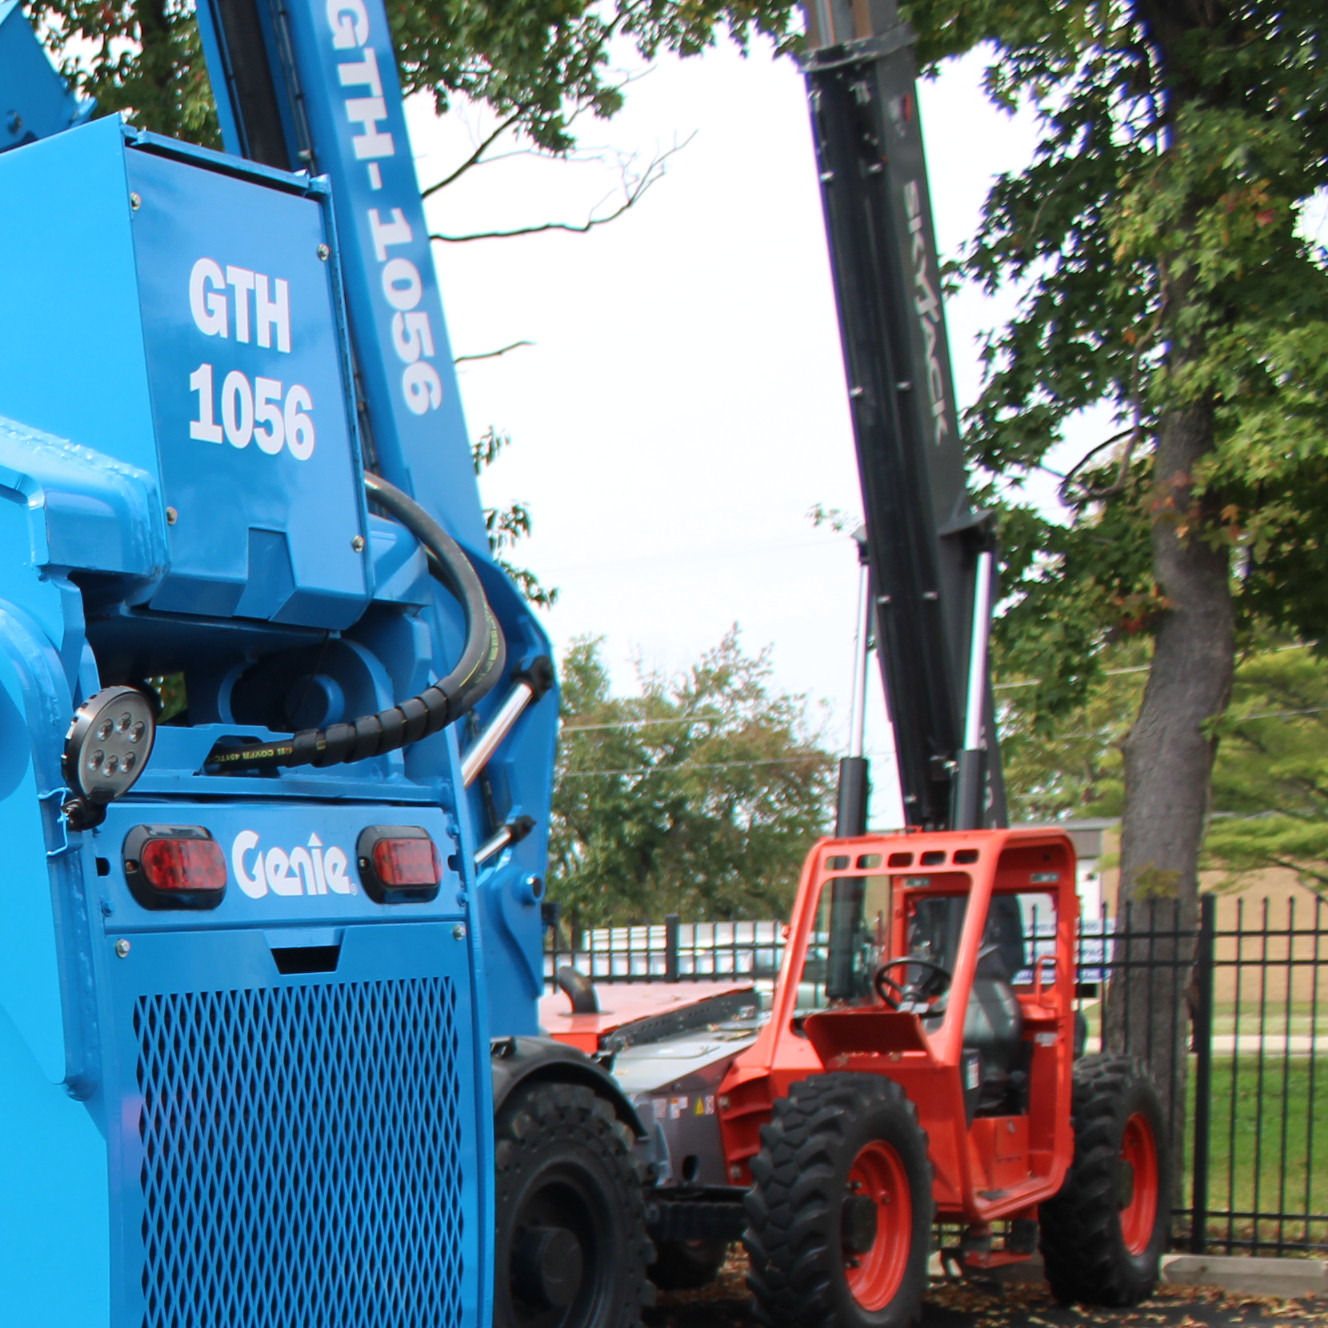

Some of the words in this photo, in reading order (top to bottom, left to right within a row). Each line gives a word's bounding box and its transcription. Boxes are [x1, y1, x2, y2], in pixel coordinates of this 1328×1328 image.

[326, 0, 443, 416] GTH-1056
[189, 257, 291, 354] GTH
[903, 180, 949, 446] SKYJACK
[189, 363, 315, 461] 1056
[231, 830, 352, 899] Genie
